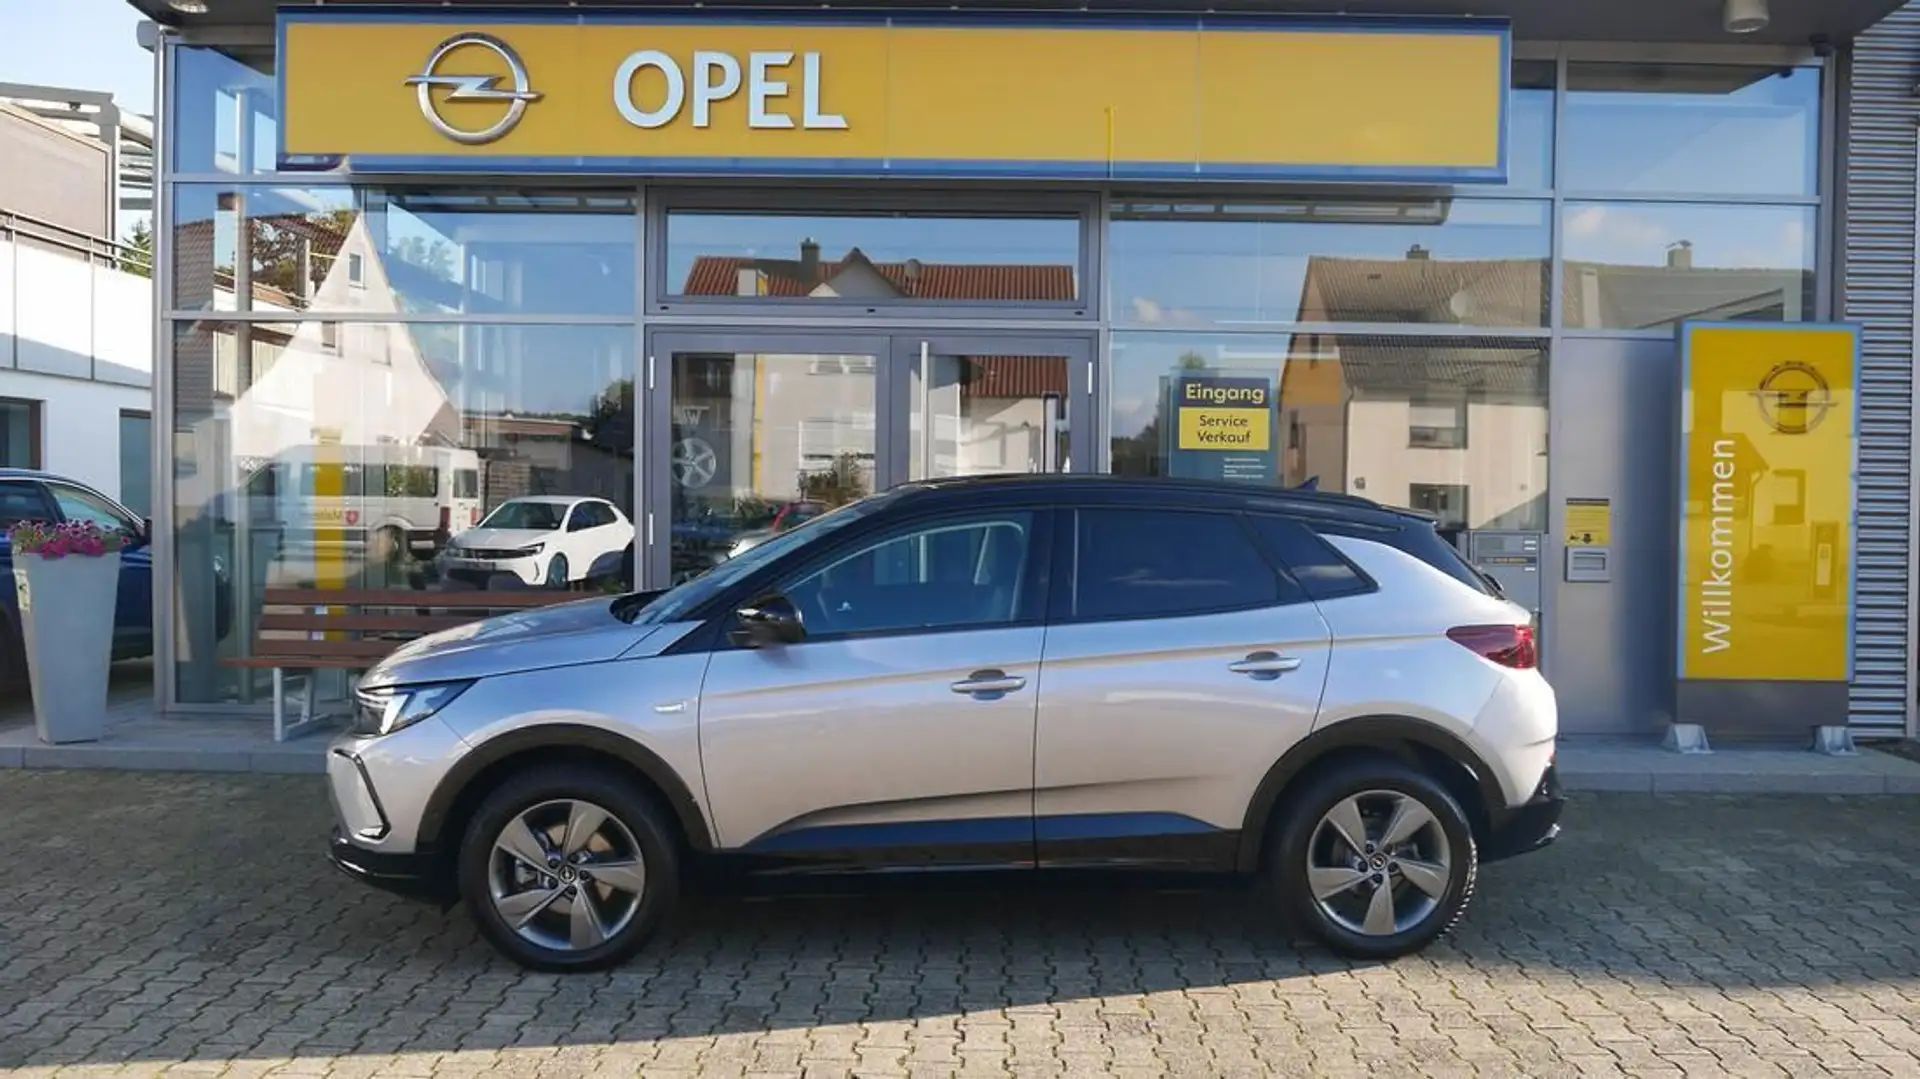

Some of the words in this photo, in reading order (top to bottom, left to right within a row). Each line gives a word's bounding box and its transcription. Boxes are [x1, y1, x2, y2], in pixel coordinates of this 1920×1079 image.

[613, 50, 849, 128] OPEL
[1185, 383, 1264, 404] Eingang
[1199, 415, 1248, 427] Service
[1197, 430, 1251, 443] Verkauf
[1702, 439, 1735, 654] Willkommen
